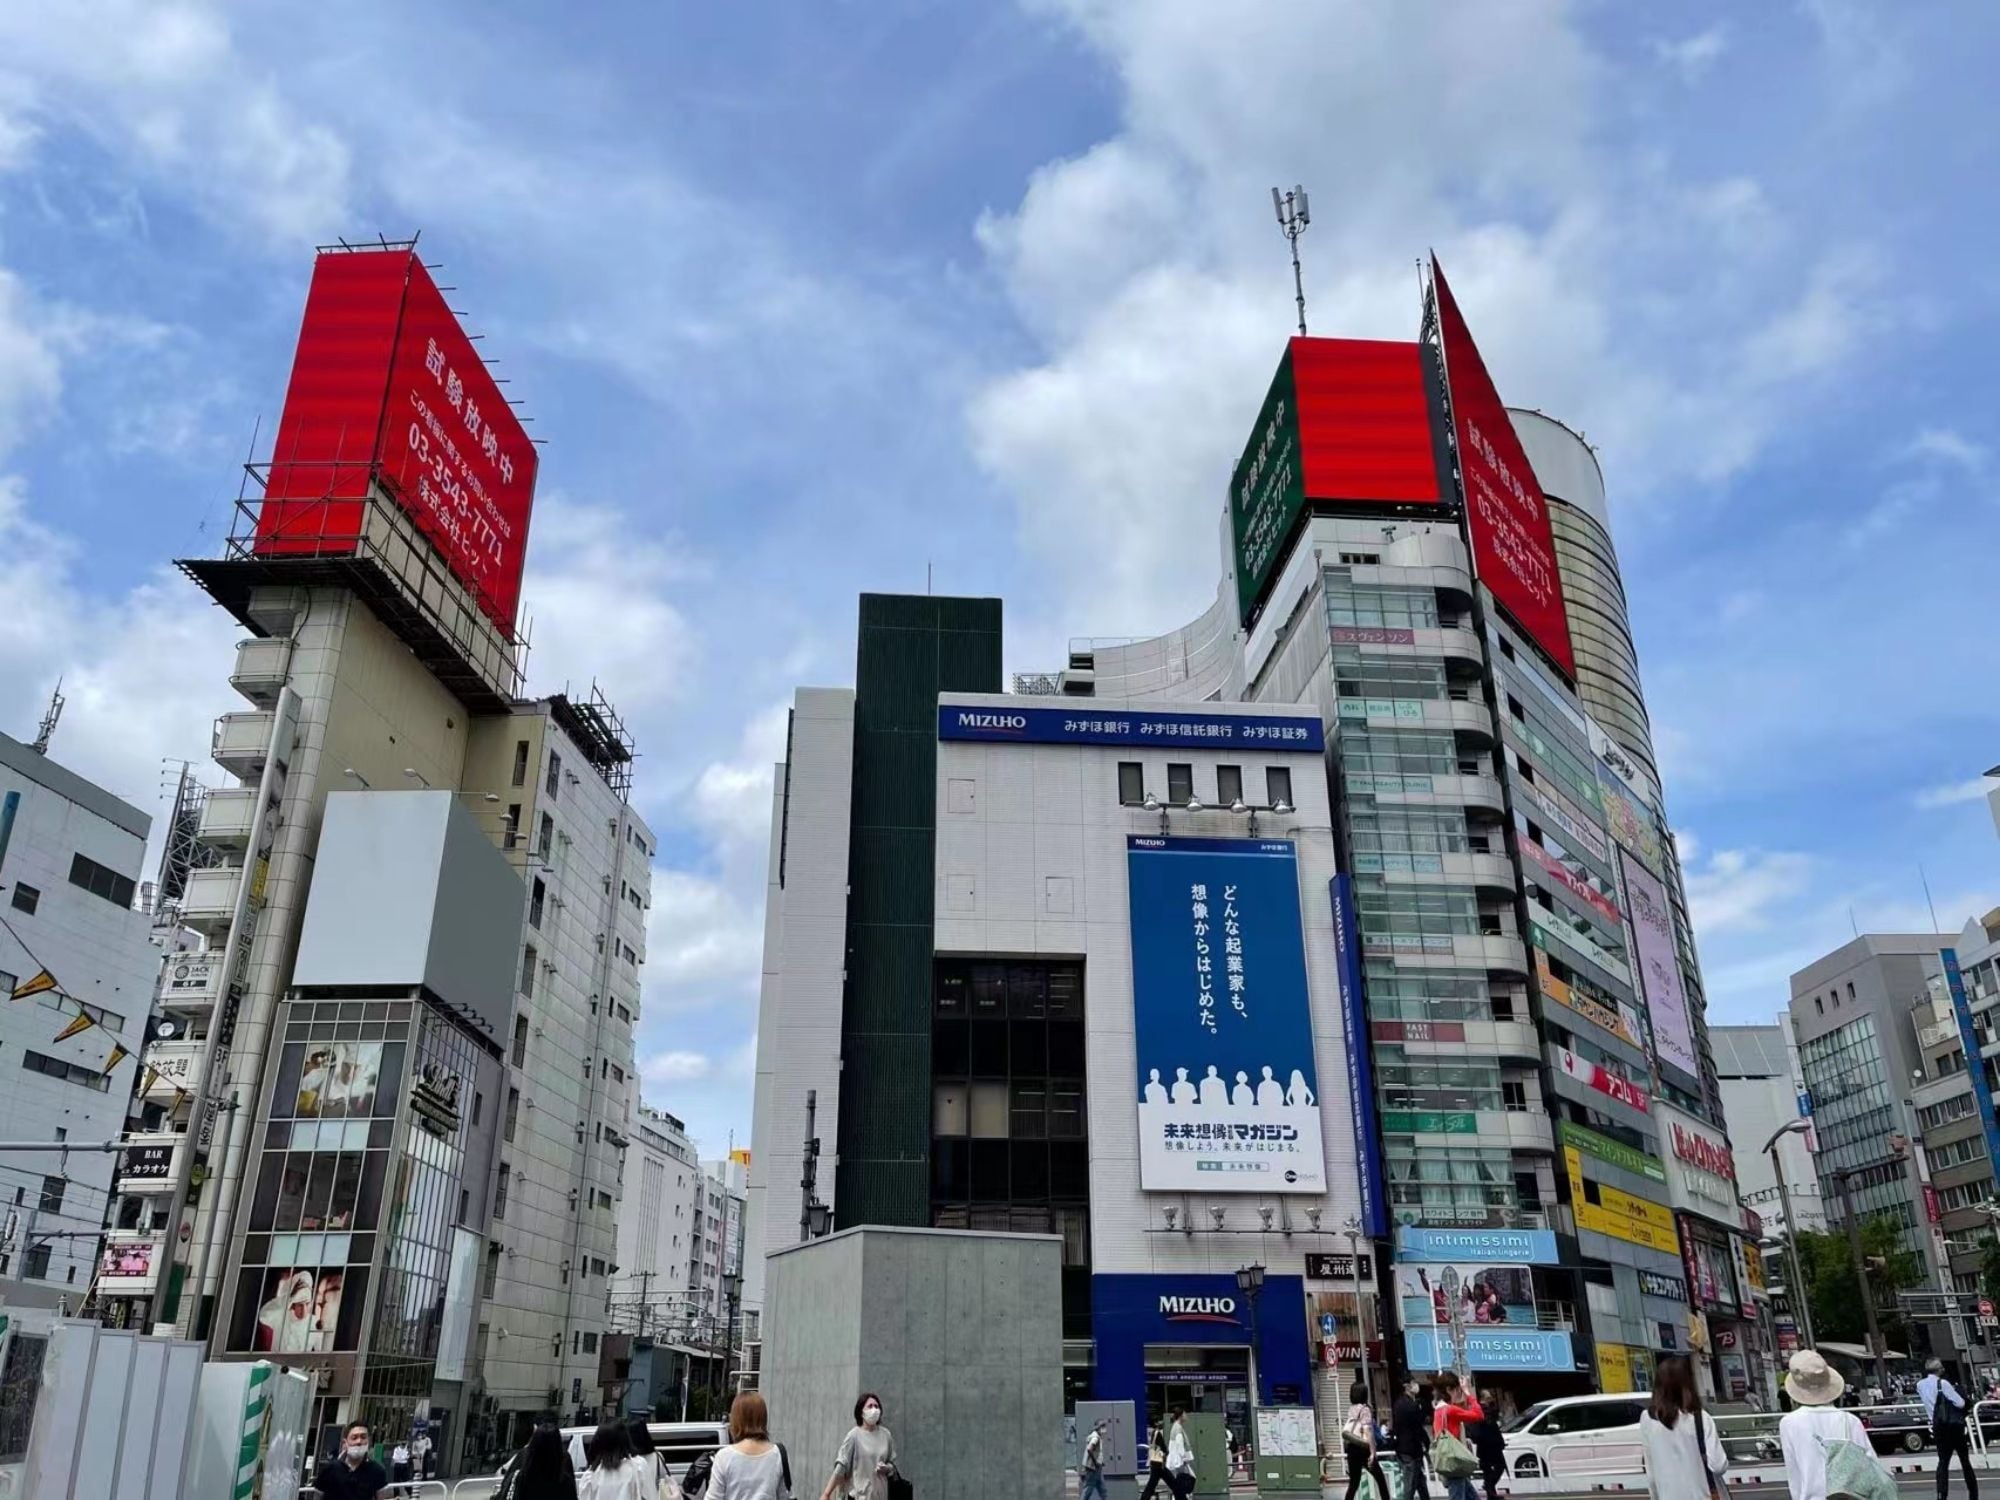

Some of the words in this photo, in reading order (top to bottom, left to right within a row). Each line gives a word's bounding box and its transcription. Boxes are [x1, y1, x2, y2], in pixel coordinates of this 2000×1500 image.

[425, 337, 513, 485] 試験放映中
[408, 422, 503, 567] 03-3543-7771
[958, 712, 1027, 730] MIZUHO
[1063, 719, 1130, 735] みずほ銀行
[1139, 722, 1233, 738] みずほ信託銀行
[1242, 725, 1309, 741] みずほ証券
[1135, 838, 1166, 847] MIZUHO
[1223, 884, 1248, 1020] どんな起業家も、
[1191, 883, 1218, 1035] 想像からはじめた。
[1406, 1023, 1428, 1032] FAST
[1407, 1032, 1430, 1040] NAIL
[1605, 1072, 1633, 1105] アコム
[144, 1149, 163, 1160] BAR
[132, 1163, 170, 1175] カラオケ
[1429, 1234, 1530, 1247] intimissimi
[1470, 1248, 1496, 1257] Italian
[1159, 1295, 1236, 1314] MIZUHO
[1439, 1339, 1541, 1351] inimissimi
[1481, 1353, 1508, 1361] Italian
